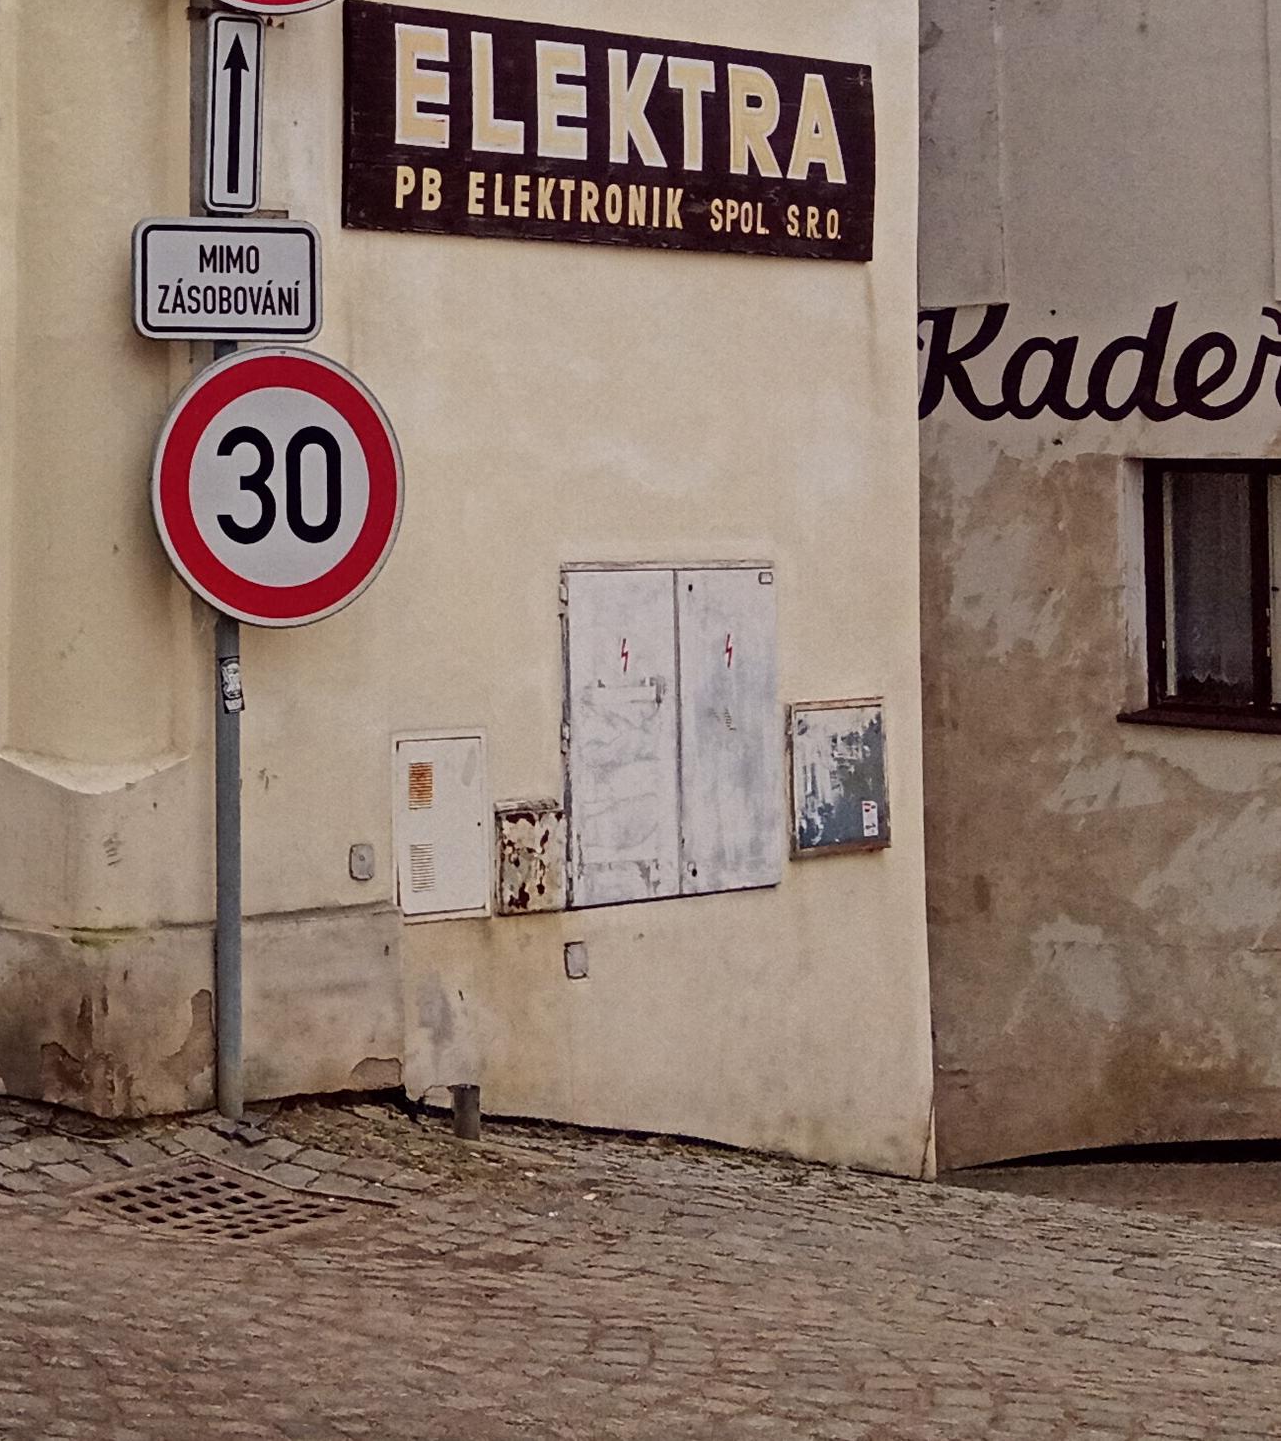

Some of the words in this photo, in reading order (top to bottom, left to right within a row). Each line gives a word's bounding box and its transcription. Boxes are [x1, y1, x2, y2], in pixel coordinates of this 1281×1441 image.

[394, 22, 847, 185] ELEKTRA
[394, 165, 442, 212] PB
[467, 171, 684, 230] ELEKTRONIK
[709, 197, 770, 235] SPOL.
[198, 244, 260, 275] MIMO
[157, 278, 301, 316] ZÁSOBOVÁNÍ
[216, 425, 342, 545] 30
